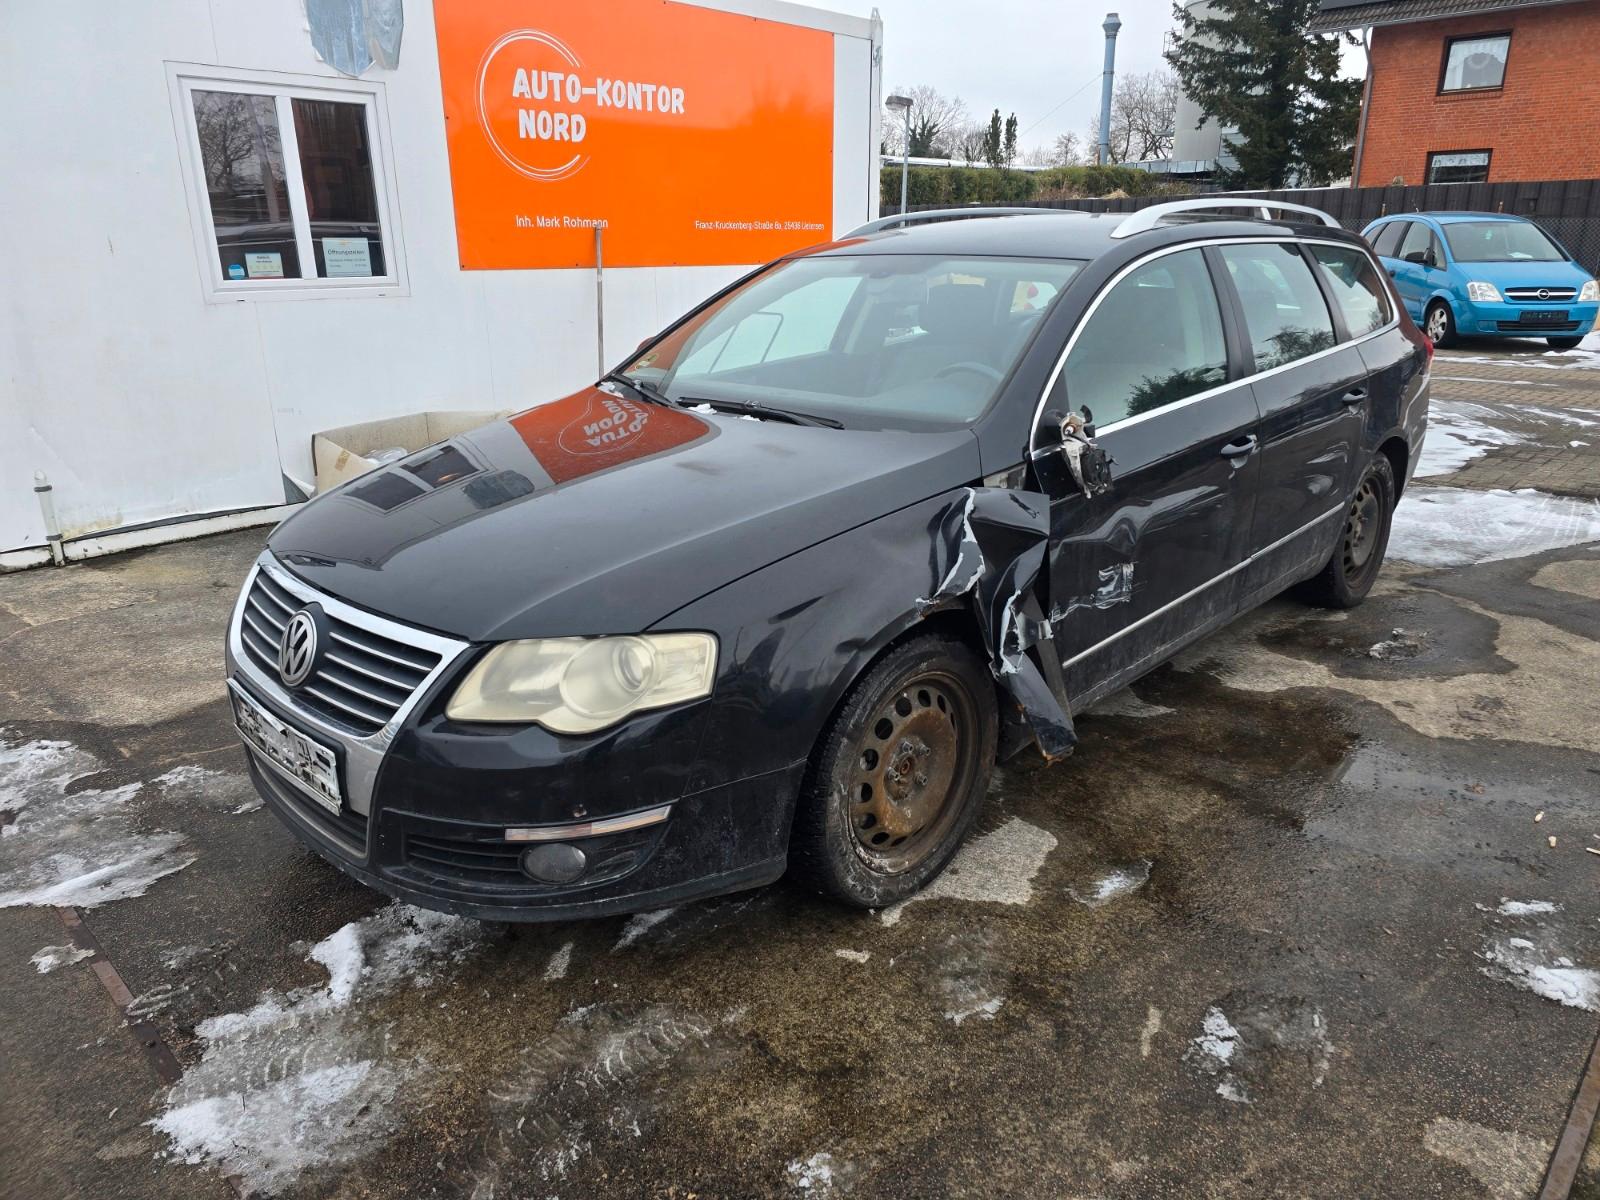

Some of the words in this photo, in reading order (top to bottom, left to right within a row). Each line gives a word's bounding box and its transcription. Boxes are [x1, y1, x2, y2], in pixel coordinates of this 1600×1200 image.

[512, 67, 685, 114] AUTO-KONTOR
[518, 108, 587, 143] NORD
[515, 215, 534, 228] Inh.
[536, 215, 560, 228] Mark
[563, 216, 608, 228] Rohmann
